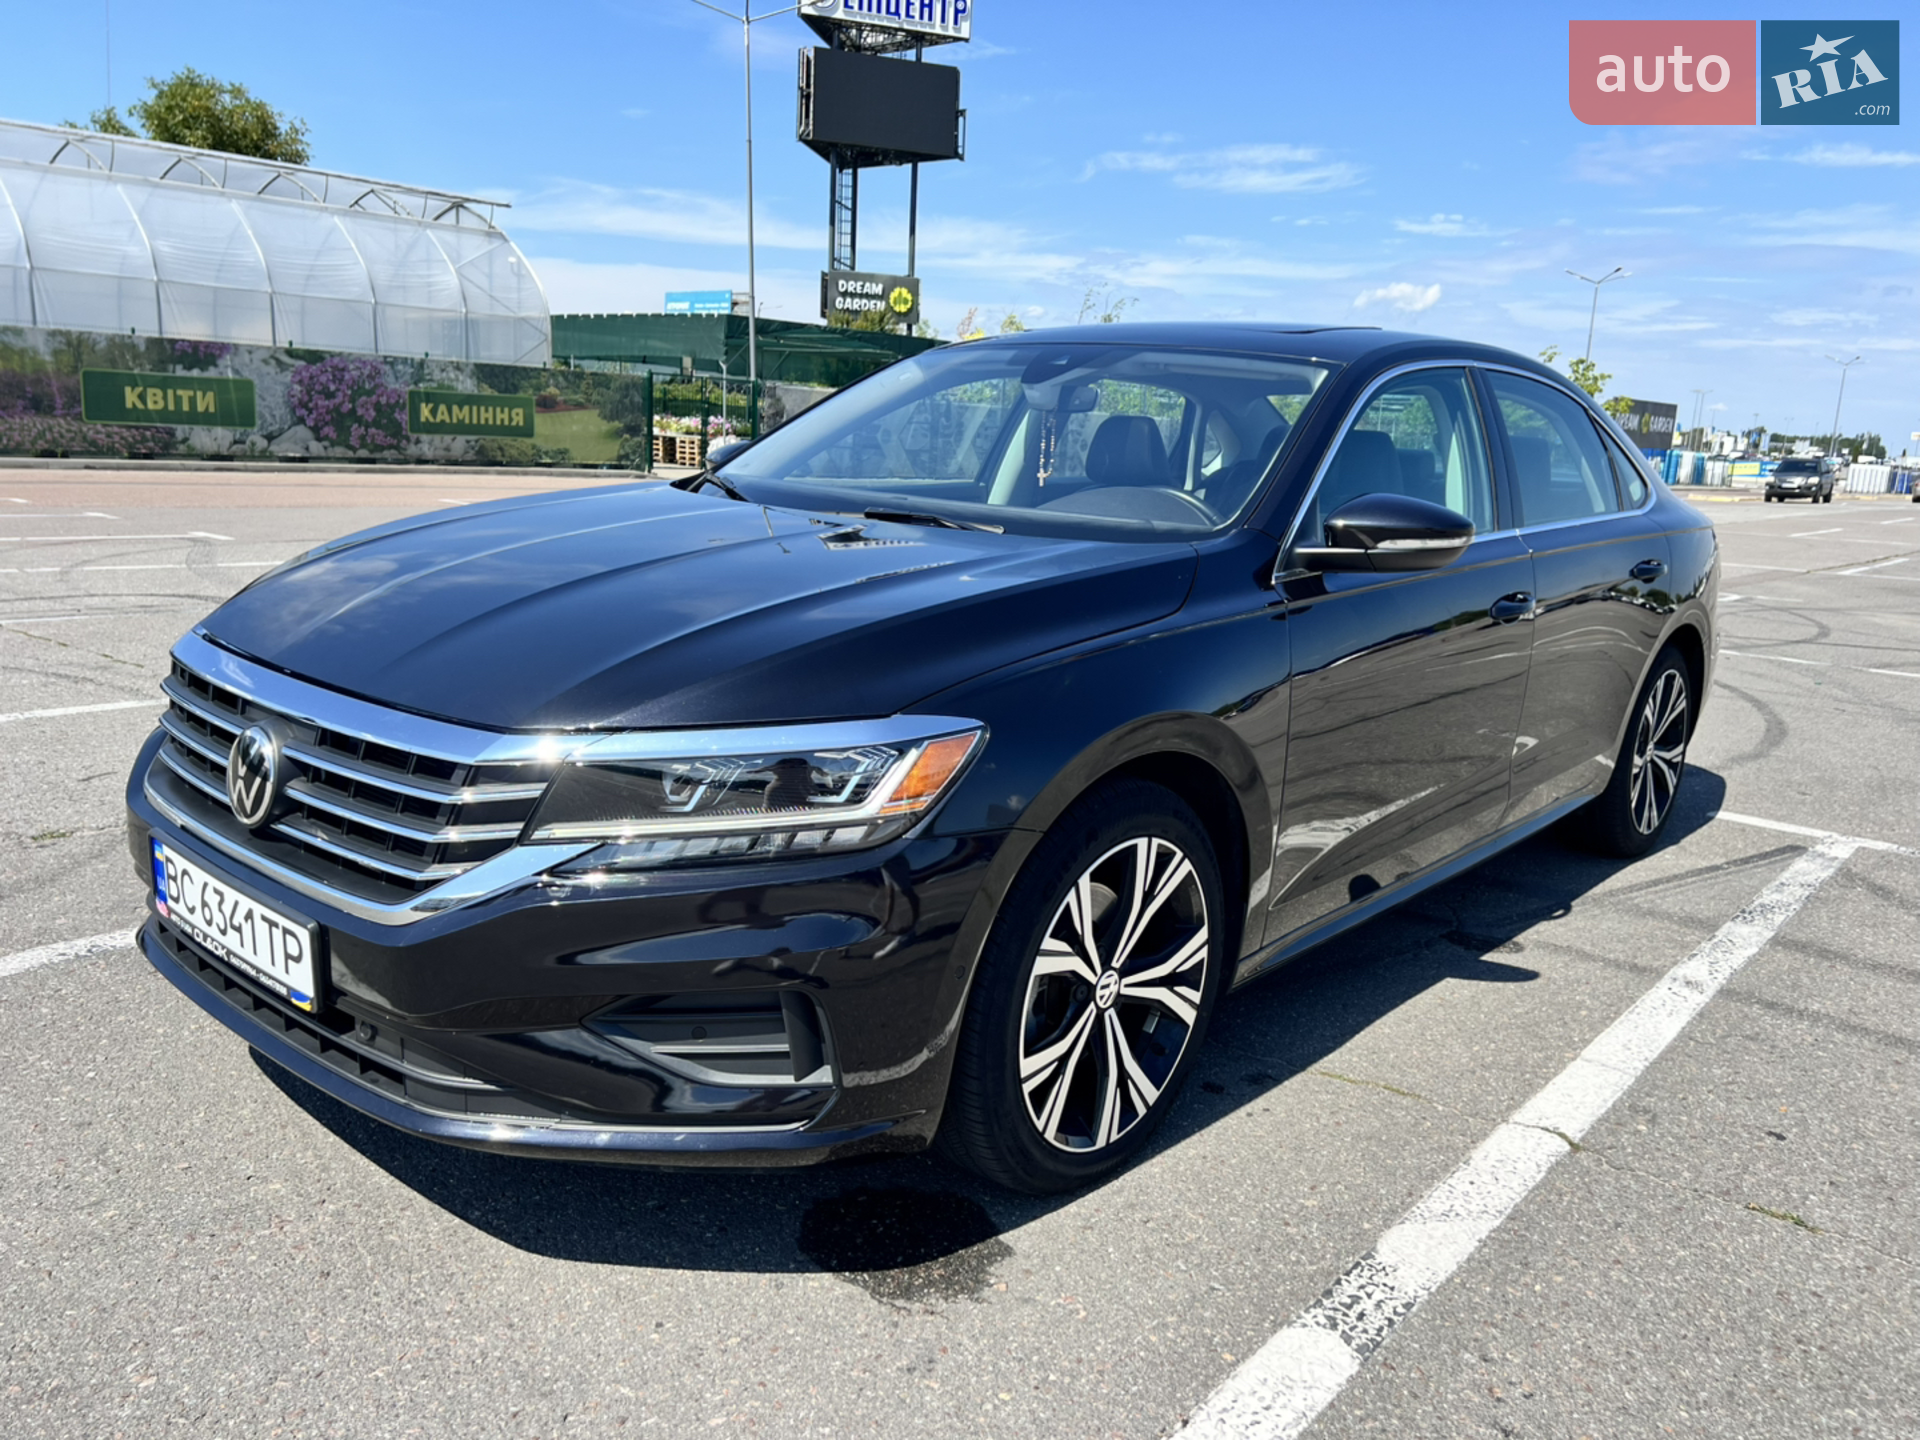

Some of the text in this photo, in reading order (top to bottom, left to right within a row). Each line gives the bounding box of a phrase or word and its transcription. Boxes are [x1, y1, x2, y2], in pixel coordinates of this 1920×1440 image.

[838, 280, 883, 295] DREAM
[835, 297, 886, 312] GARDEN
[124, 386, 215, 413] КВІТИ
[420, 402, 525, 426] КАМІННЯ
[1649, 415, 1674, 434] GARDEN
